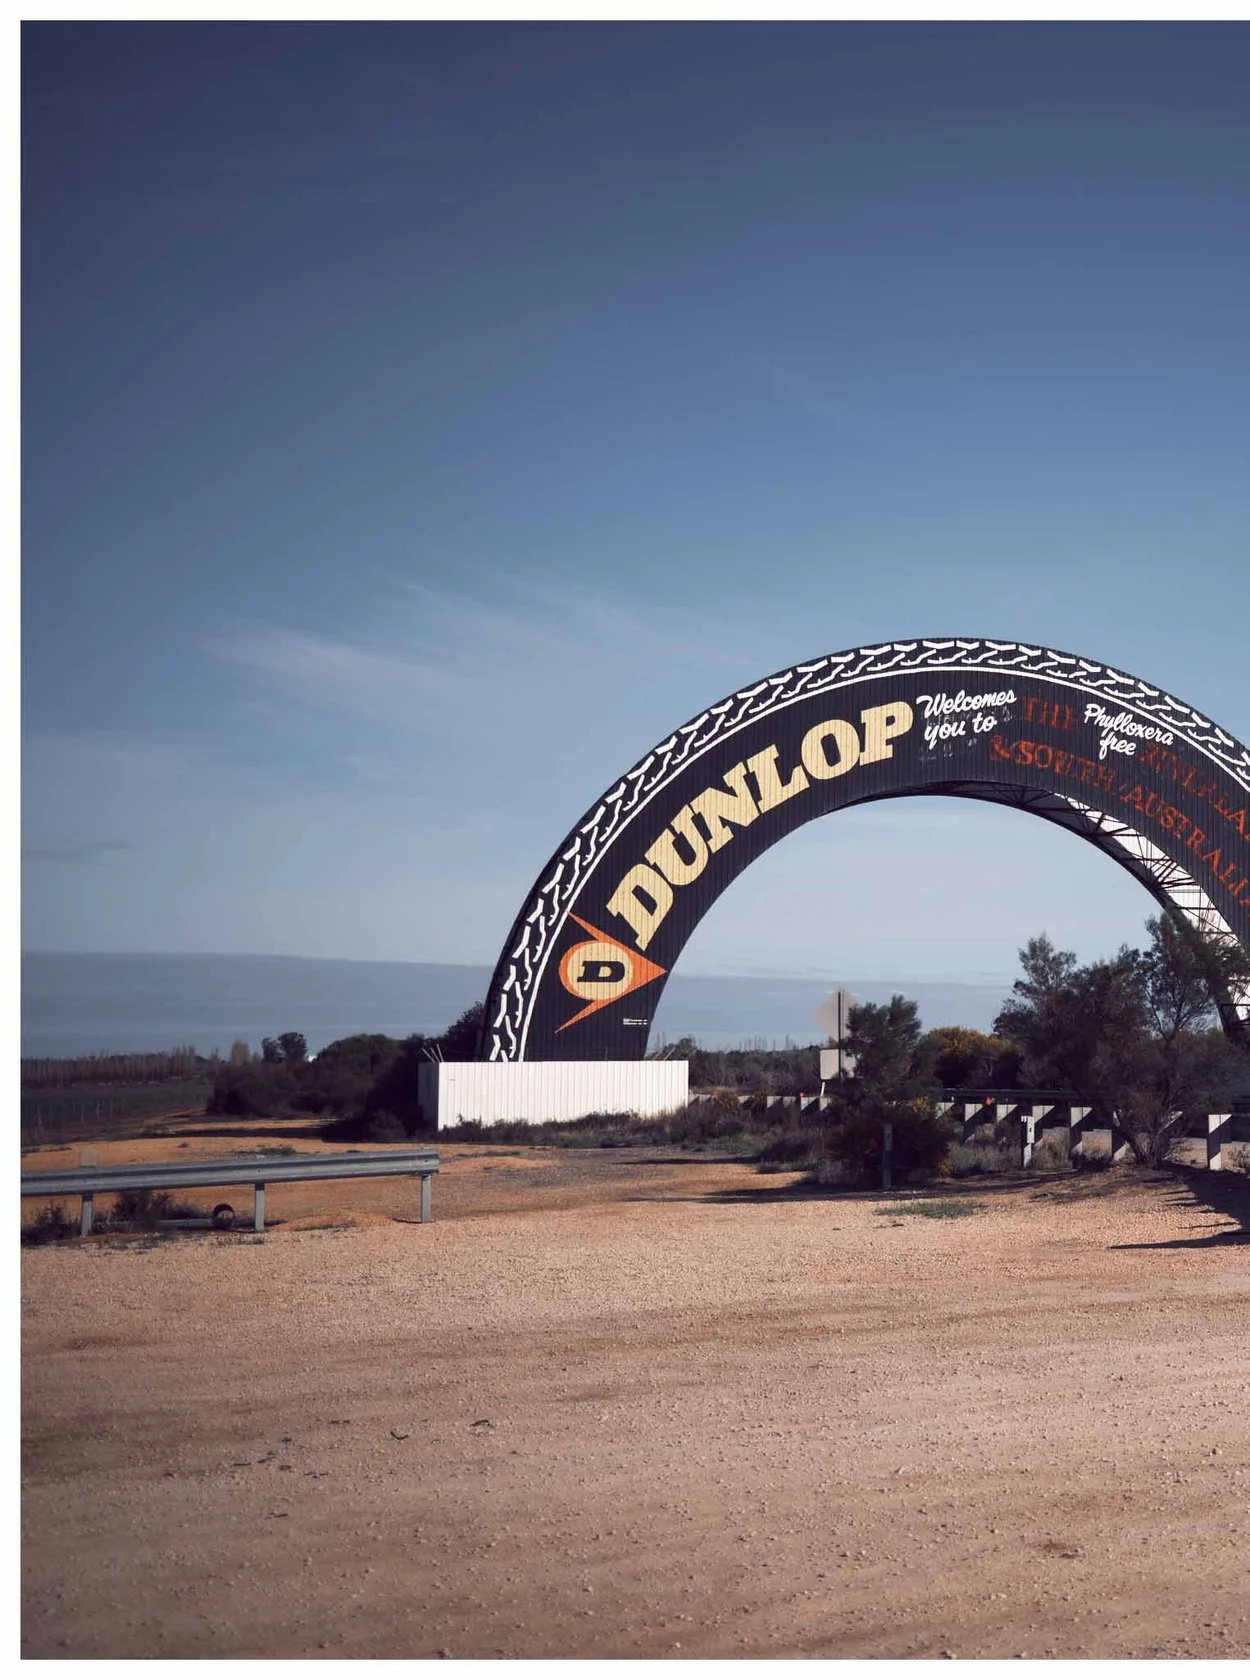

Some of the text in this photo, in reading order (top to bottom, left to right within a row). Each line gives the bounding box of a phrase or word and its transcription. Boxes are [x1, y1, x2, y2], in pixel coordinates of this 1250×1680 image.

[916, 689, 1018, 719] Welcomes
[924, 720, 966, 750] you
[972, 712, 998, 733] to
[1083, 703, 1174, 746] Phylloxera
[1099, 731, 1137, 760] free
[606, 701, 914, 951] DUNLOP
[577, 960, 626, 983] D
